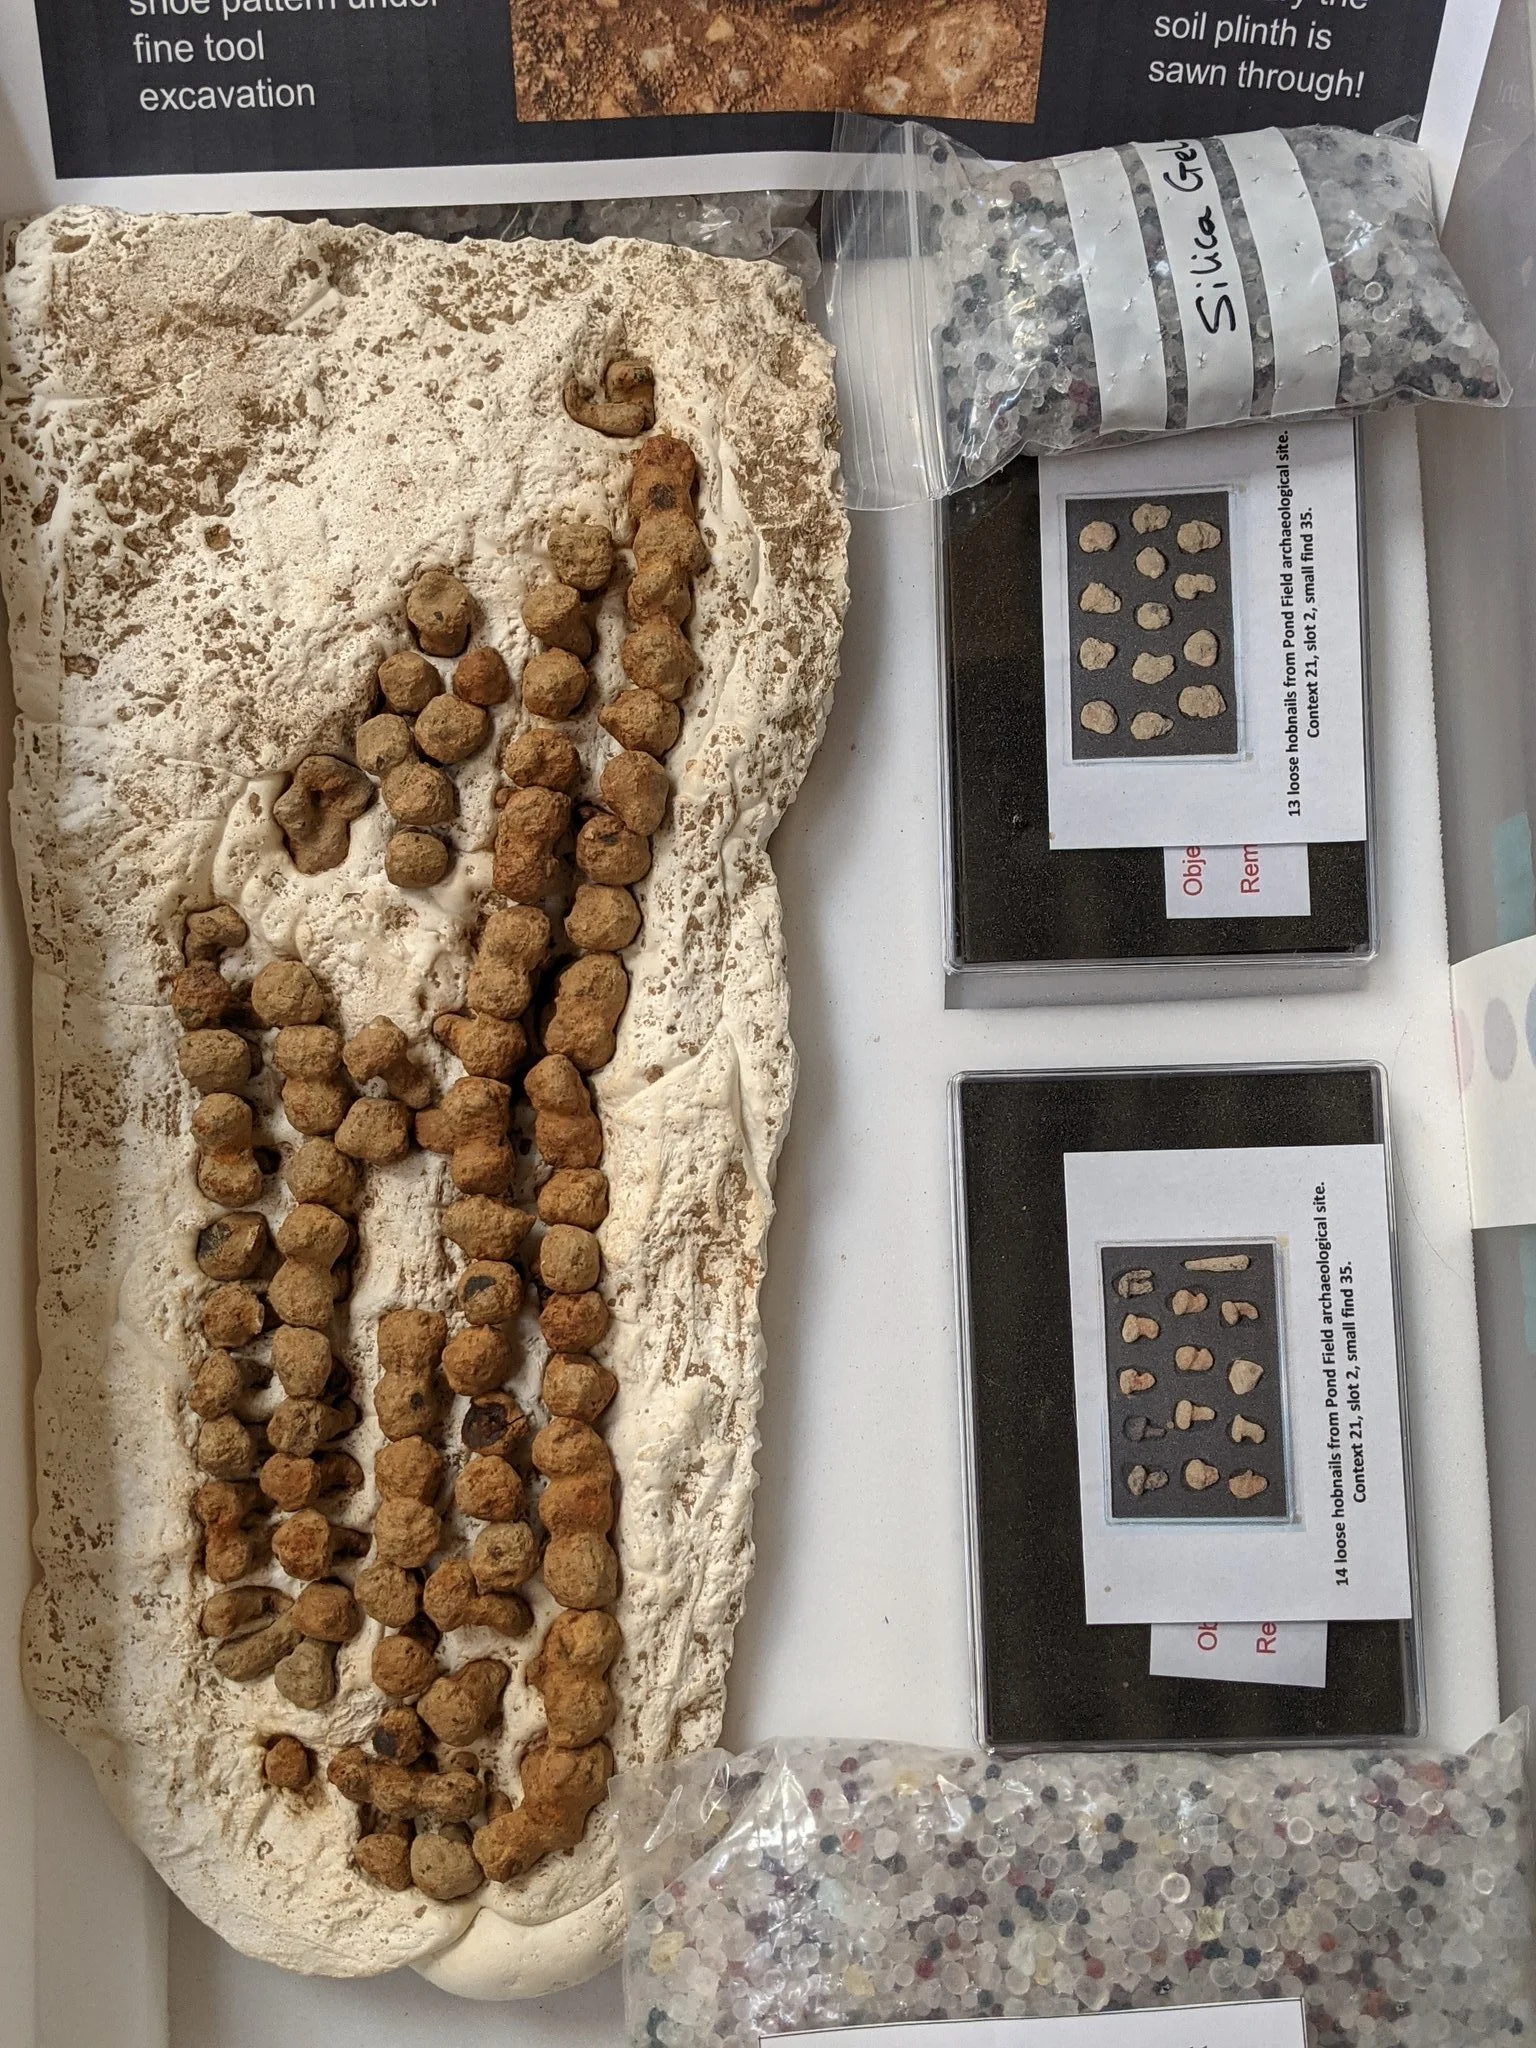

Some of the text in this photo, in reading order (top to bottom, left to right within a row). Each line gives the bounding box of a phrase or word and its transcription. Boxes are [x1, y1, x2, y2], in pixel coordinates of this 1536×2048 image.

[133, 30, 264, 63] fine tool
[1154, 11, 1332, 50] soil plinth is
[139, 78, 315, 111] excavation
[1148, 60, 1364, 101] sawn through!
[1156, 141, 1236, 335] Silica Gel
[1276, 430, 1300, 817] 13 loose hobnails from Pond Field archaeological site.
[1300, 507, 1320, 738] Context 21, slot 2, small find 35.
[1182, 845, 1206, 896] Obje
[1240, 844, 1260, 893] Rem
[1313, 1181, 1349, 1586] 14 loose hobnails from Pond Field archaeological site.
[1340, 1261, 1366, 1503] Context 21, slot 2, small find 35.
[1256, 1621, 1277, 1654] Re
